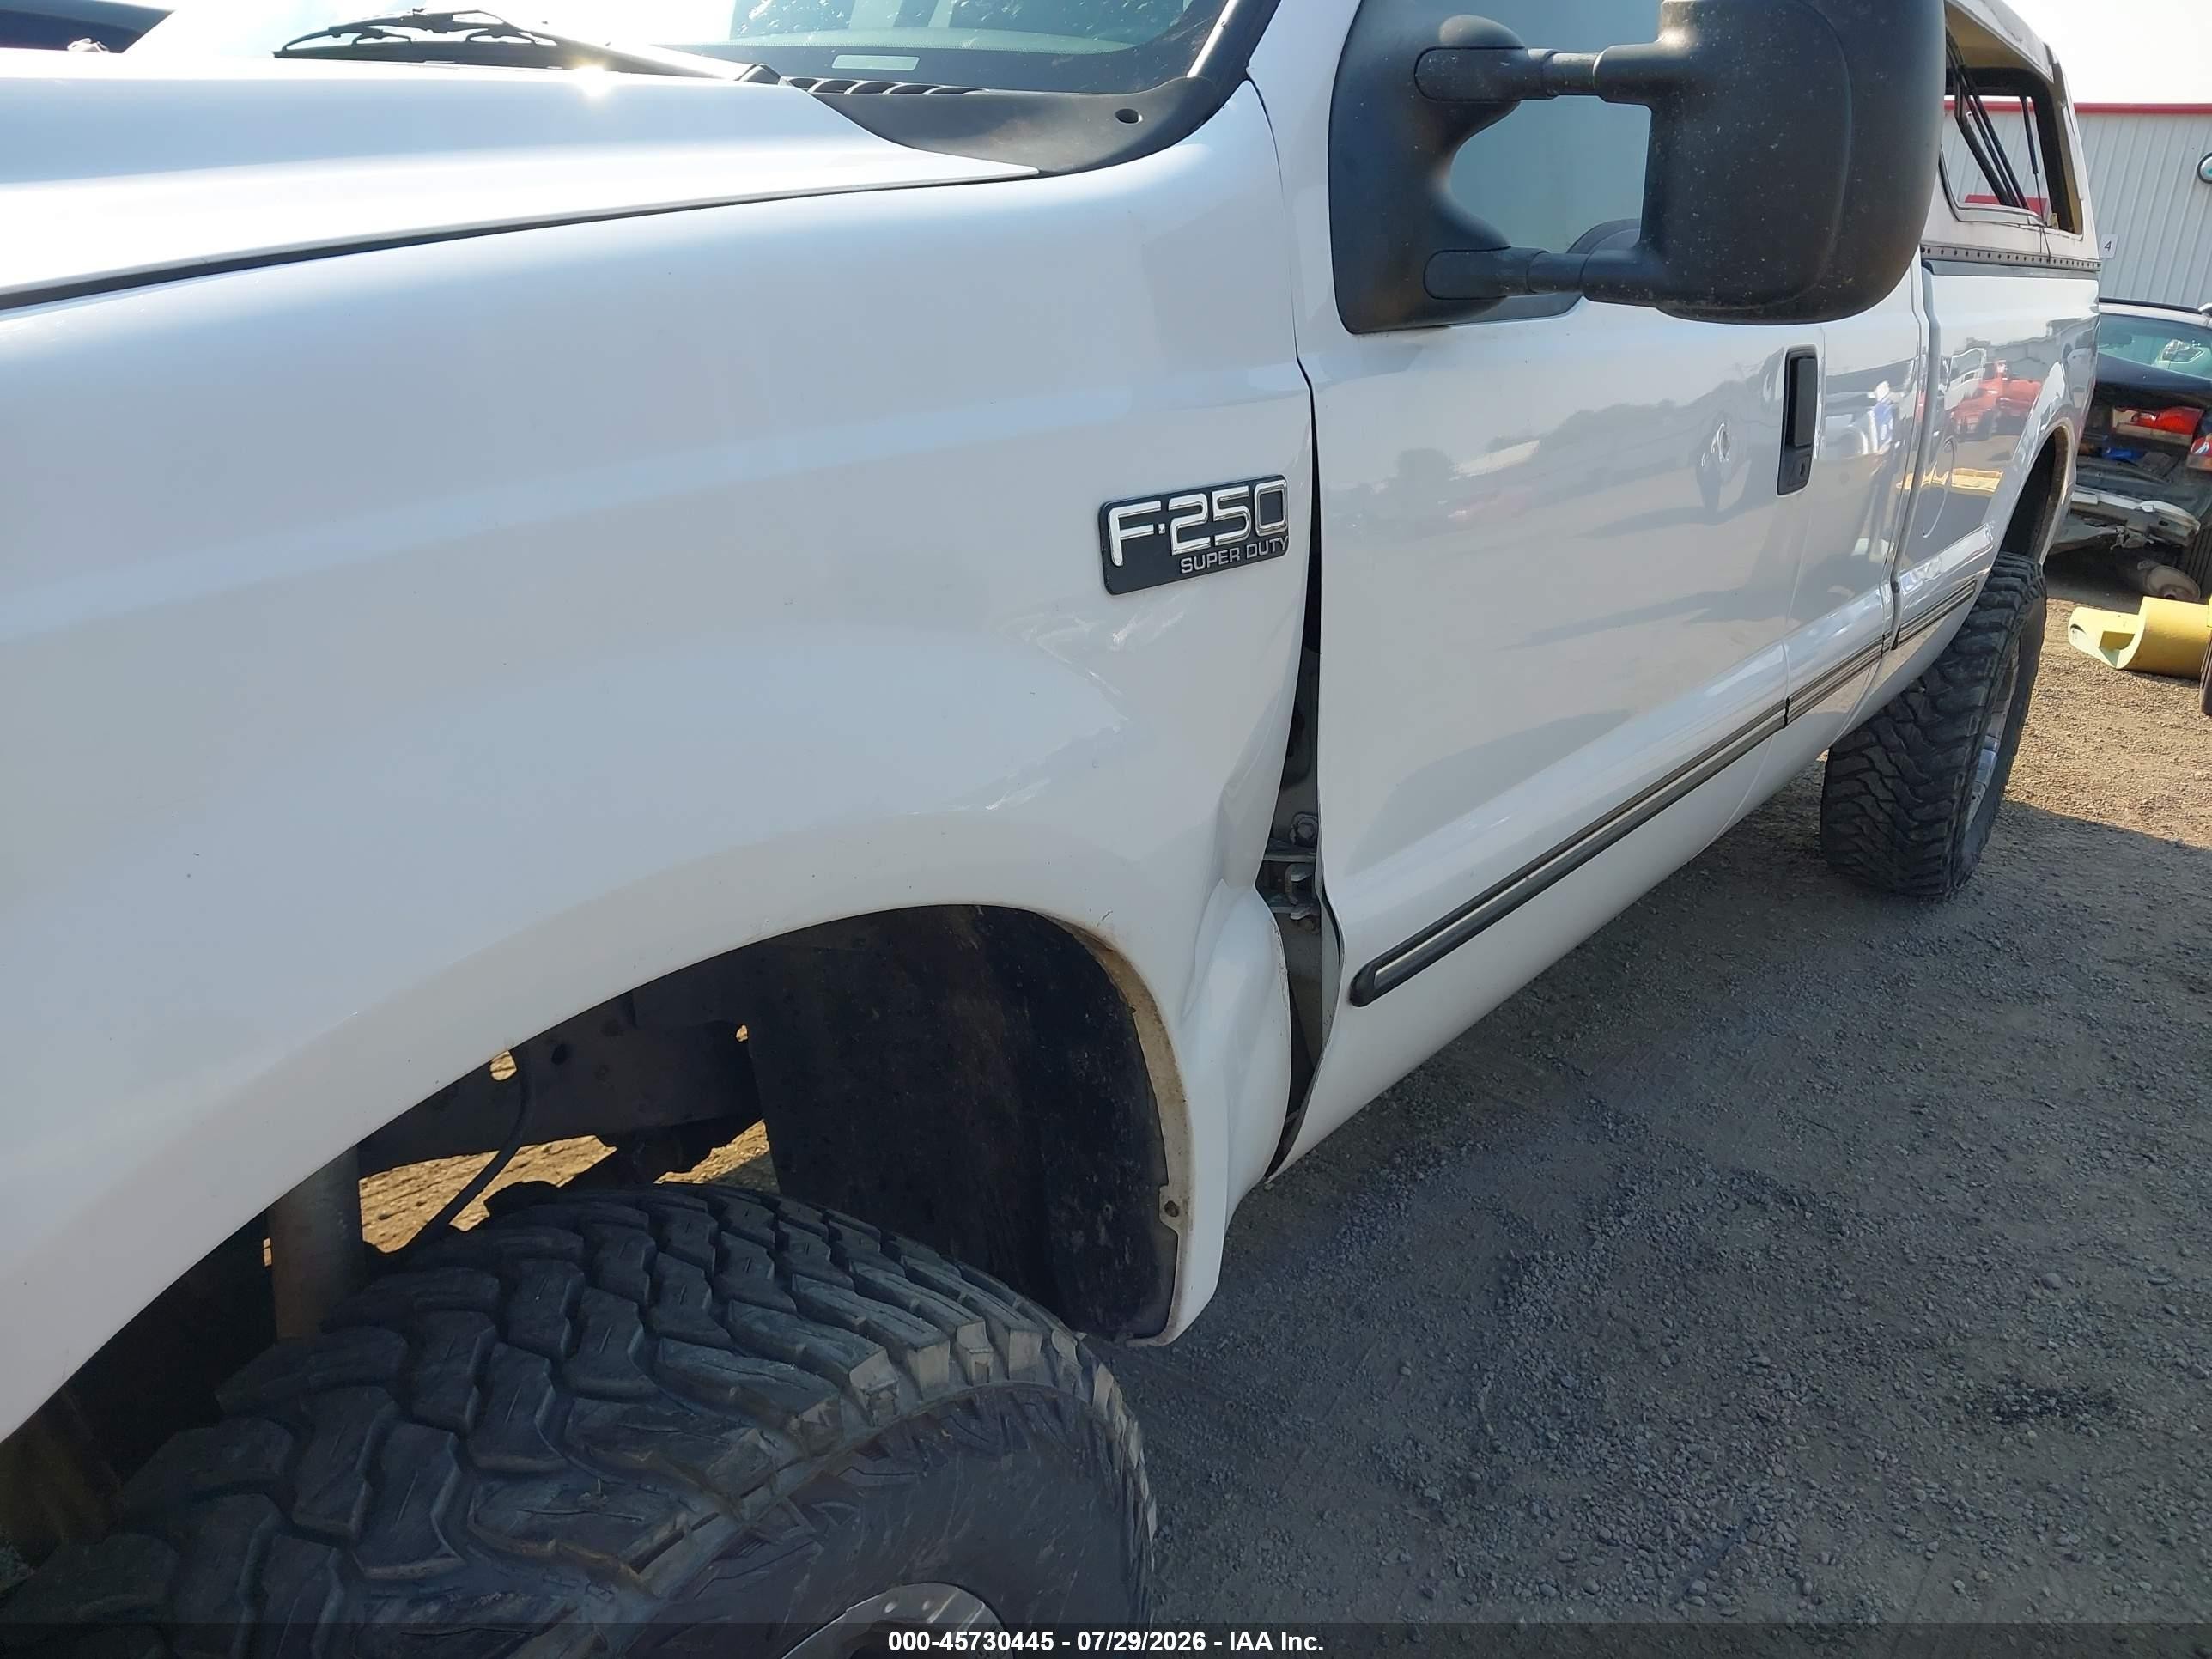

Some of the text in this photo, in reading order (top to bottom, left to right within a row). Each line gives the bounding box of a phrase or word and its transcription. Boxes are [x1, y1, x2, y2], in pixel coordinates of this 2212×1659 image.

[2104, 240, 2112, 252] 4
[1180, 536, 1289, 574] SUPER DUTY
